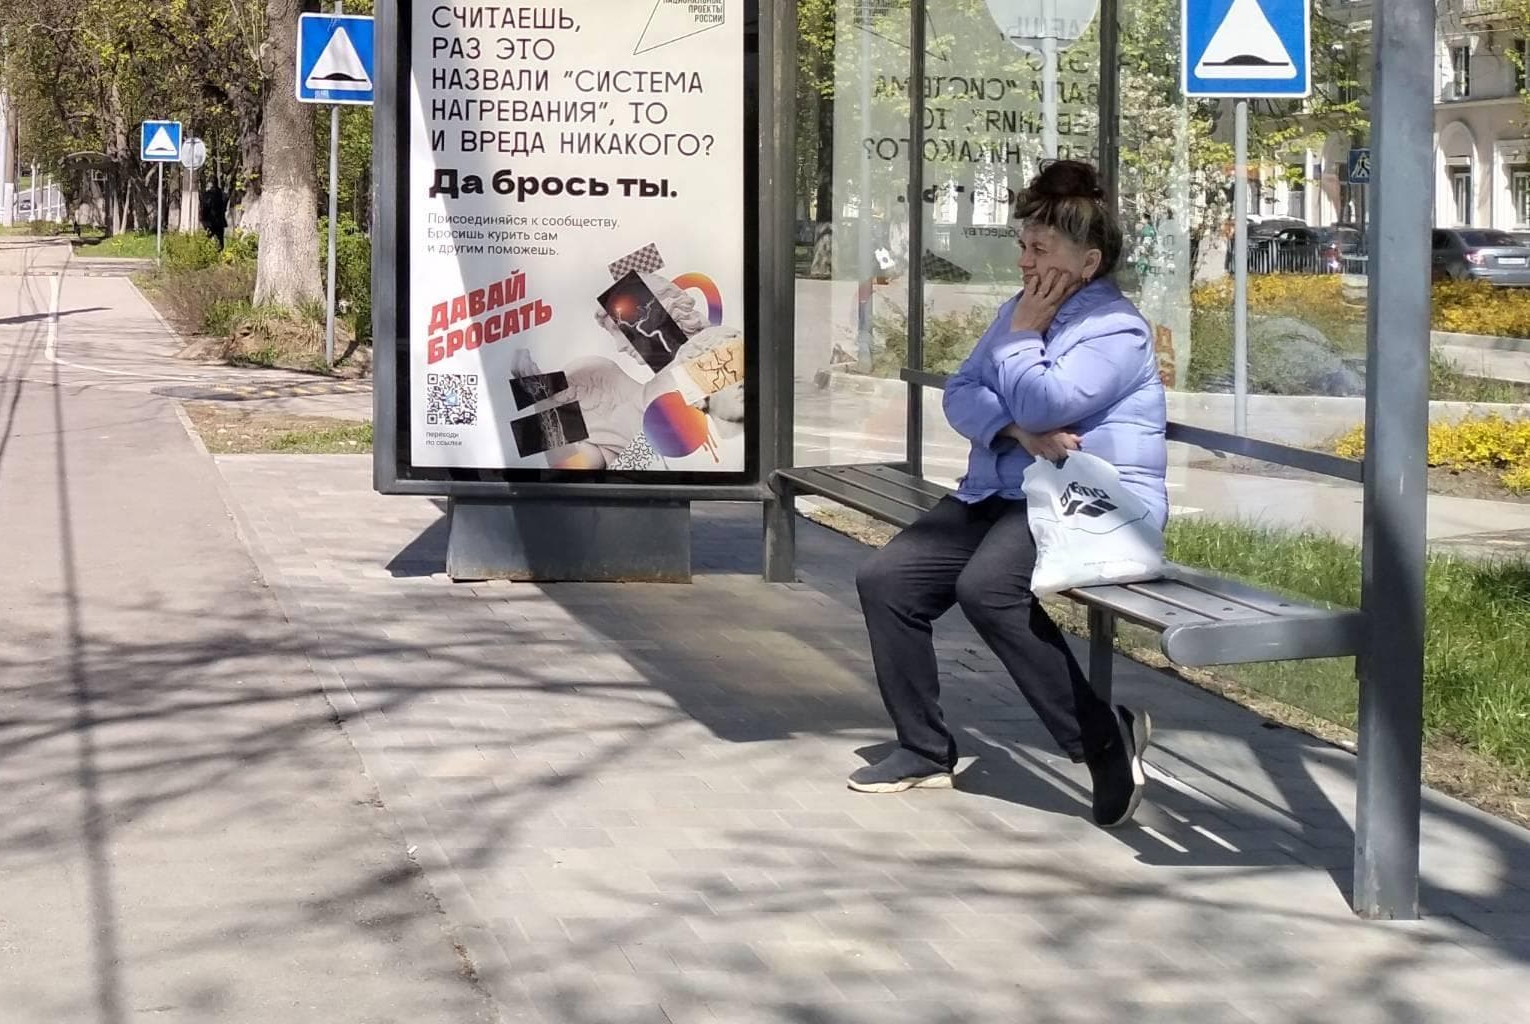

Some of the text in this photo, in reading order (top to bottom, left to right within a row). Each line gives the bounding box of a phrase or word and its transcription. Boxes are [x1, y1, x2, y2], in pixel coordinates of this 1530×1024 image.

[432, 5, 581, 32] СЧИТАЕШЬ,
[688, 5, 723, 14] ПРОЕКТЫ
[694, 14, 723, 23] РОССИИ
[432, 37, 555, 61] РАЗ ЭТО
[432, 67, 703, 94] НАЗВАЛИ "СИСТЕМА
[432, 99, 668, 126] НАГРЕВАНИЯ", ТО
[432, 130, 715, 157] И ВРЕДА НИКАКОГО?
[429, 168, 678, 203] Да брось ты.
[428, 212, 620, 229] Присоединяйся к сообществу.
[427, 228, 558, 242] Бросишь курить сам
[427, 244, 559, 257] и другим поможешь.
[428, 269, 526, 336] ДАВАЙ
[427, 296, 553, 365] БРОСАТЬ
[426, 431, 459, 440] переходи
[1060, 481, 1110, 507] arena
